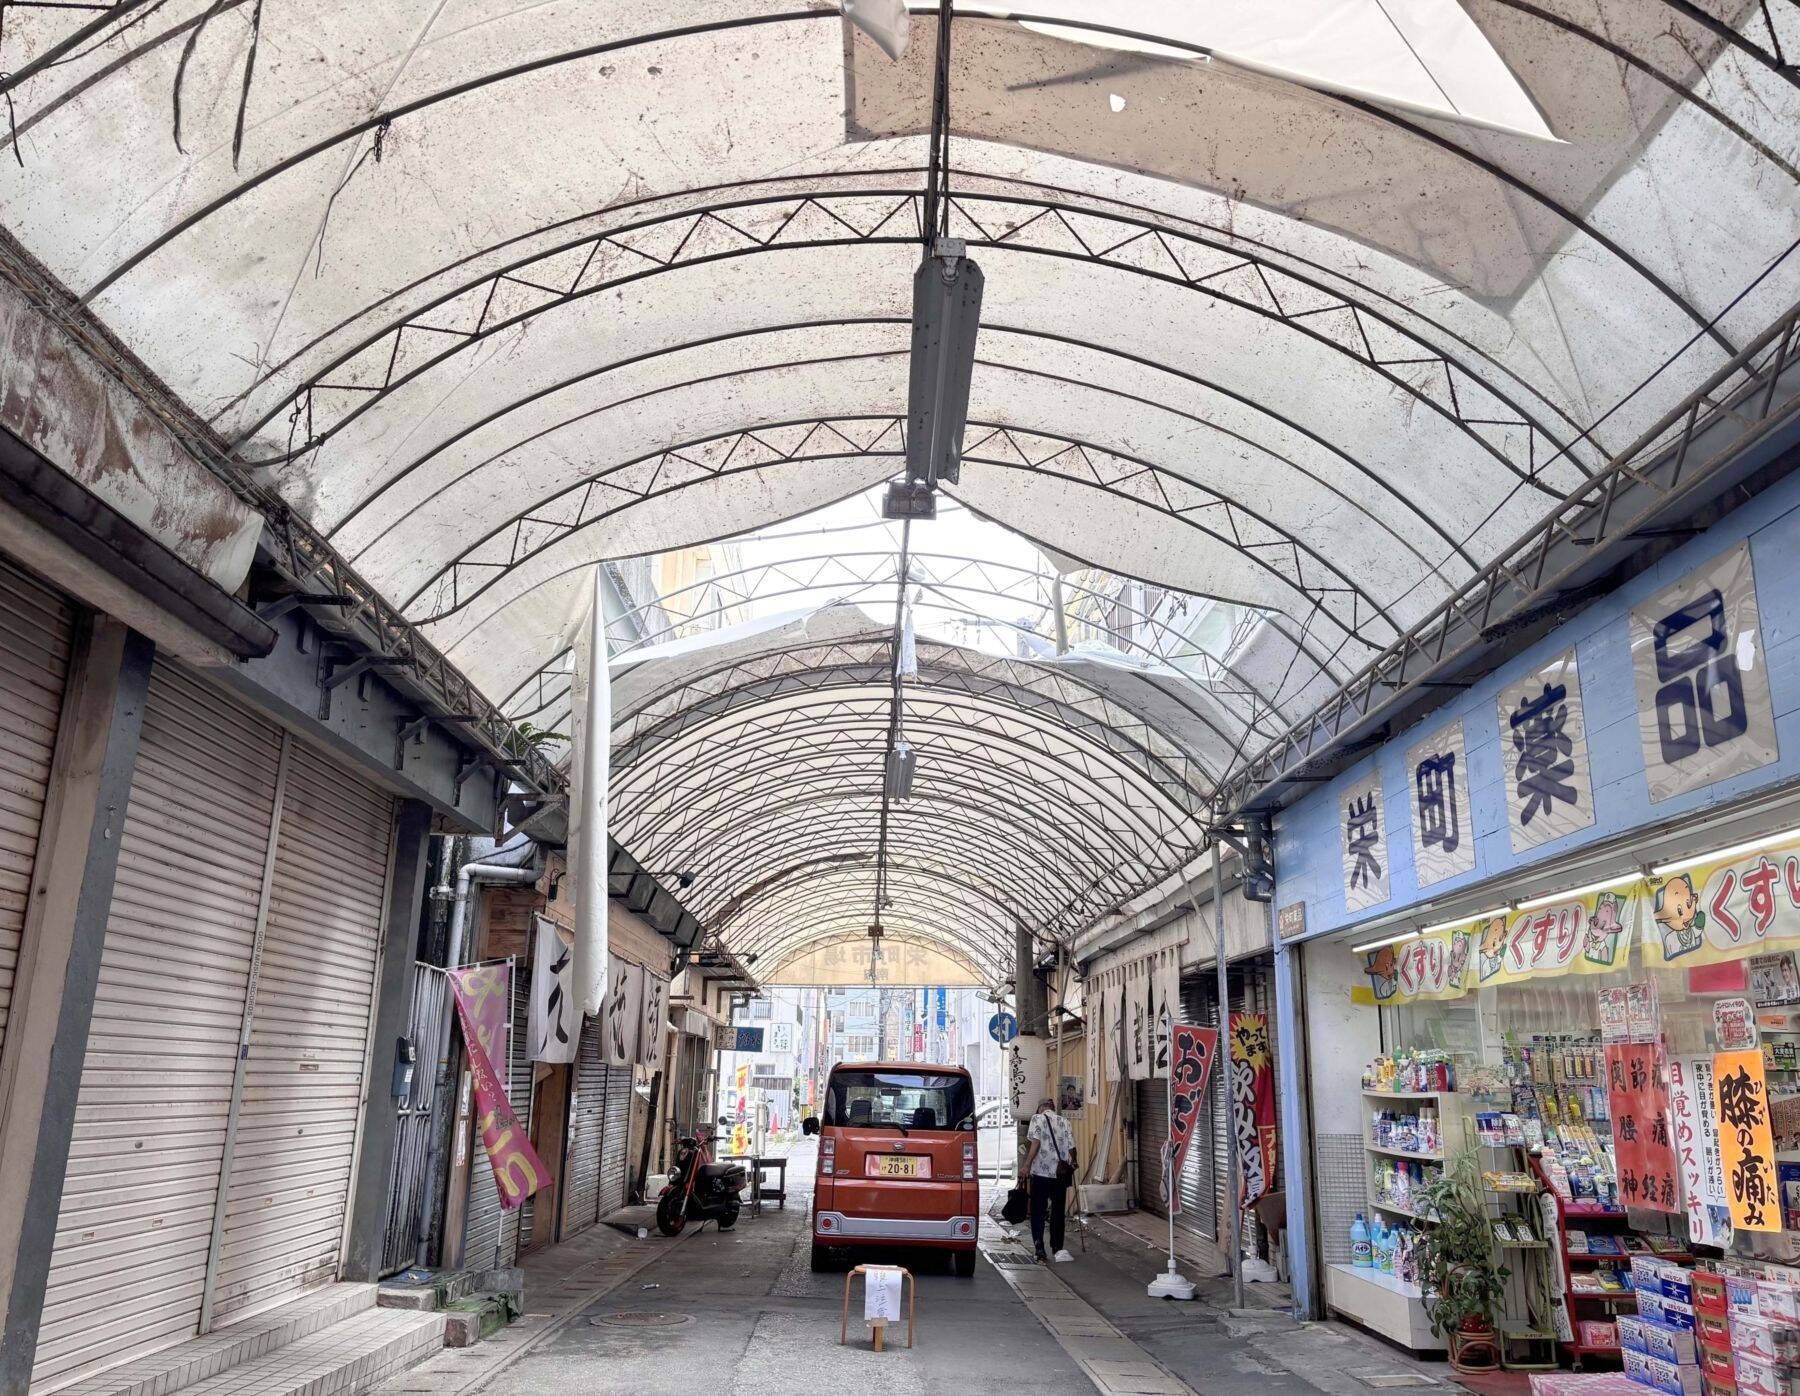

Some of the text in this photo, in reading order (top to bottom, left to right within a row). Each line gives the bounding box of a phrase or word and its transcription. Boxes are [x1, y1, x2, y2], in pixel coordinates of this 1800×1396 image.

[1347, 589, 1748, 890] 栄町薬品
[1509, 901, 1582, 969] くすり
[1401, 941, 1444, 991] くすり
[1236, 1025, 1266, 1044] やって
[1246, 1041, 1268, 1056] ます
[887, 1163, 914, 1175] 20-81
[1669, 1061, 1705, 1244] 目覚めスッキリ
[1718, 1065, 1766, 1226] 膝の痛み
